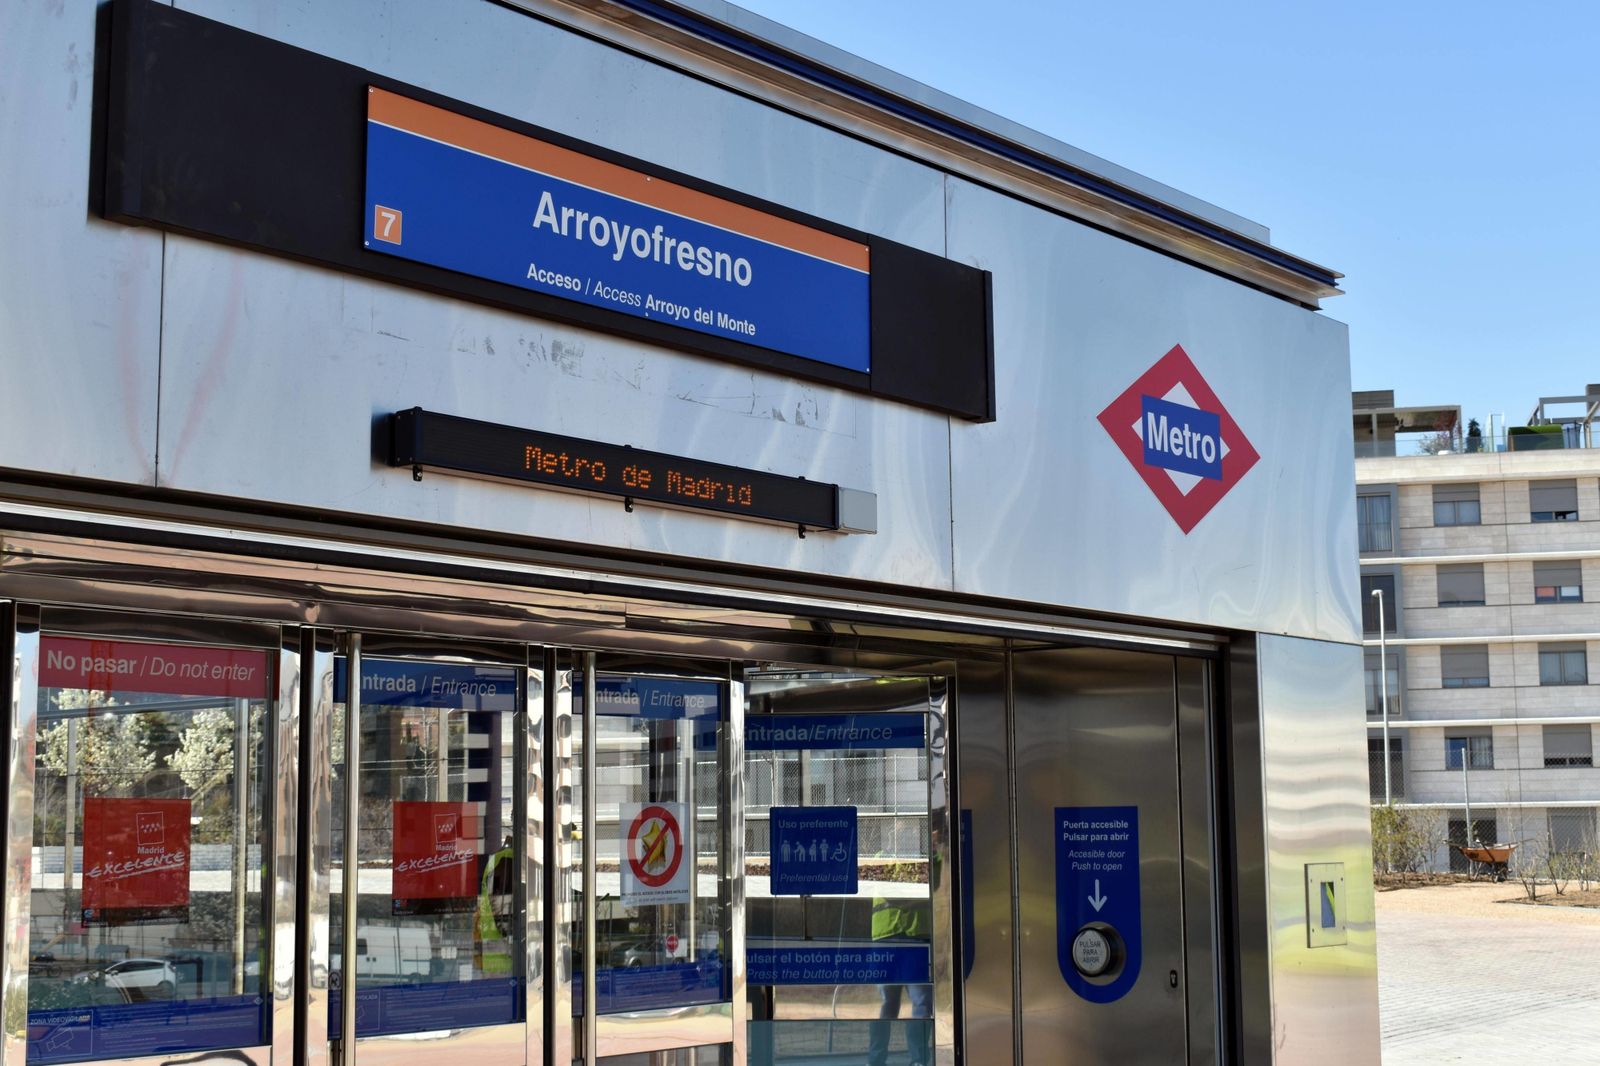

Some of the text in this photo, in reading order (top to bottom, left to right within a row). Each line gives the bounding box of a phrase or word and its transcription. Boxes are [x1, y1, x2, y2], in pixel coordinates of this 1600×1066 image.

[381, 211, 396, 237] 7
[532, 191, 752, 287] Arroyofresno
[526, 263, 581, 292] Acceso
[593, 281, 642, 307] Access
[645, 294, 690, 321] Arroyo
[693, 307, 713, 325] del
[717, 311, 756, 336] Monte
[1147, 411, 1216, 464] Metro
[525, 445, 752, 505] Metro de Madrid
[47, 650, 75, 671] No
[81, 656, 137, 676] pasar
[150, 657, 176, 677] Do
[179, 660, 209, 679] not
[211, 664, 256, 681] enter
[361, 674, 417, 693] ntrada
[430, 676, 497, 697] Entrance
[596, 688, 639, 705] ntrada
[650, 690, 705, 708] Entrance
[778, 819, 849, 831] Uso preferente
[1063, 820, 1129, 829] Puerta accesible
[1063, 832, 1129, 843] Pulsar para abrir
[137, 846, 165, 854] Madrid
[1107, 849, 1126, 858] door
[1072, 861, 1122, 872] Push to open
[780, 873, 849, 883] Preferential use
[747, 951, 895, 965] ulsar el botón para abrir
[747, 968, 888, 982] Press the button to open
